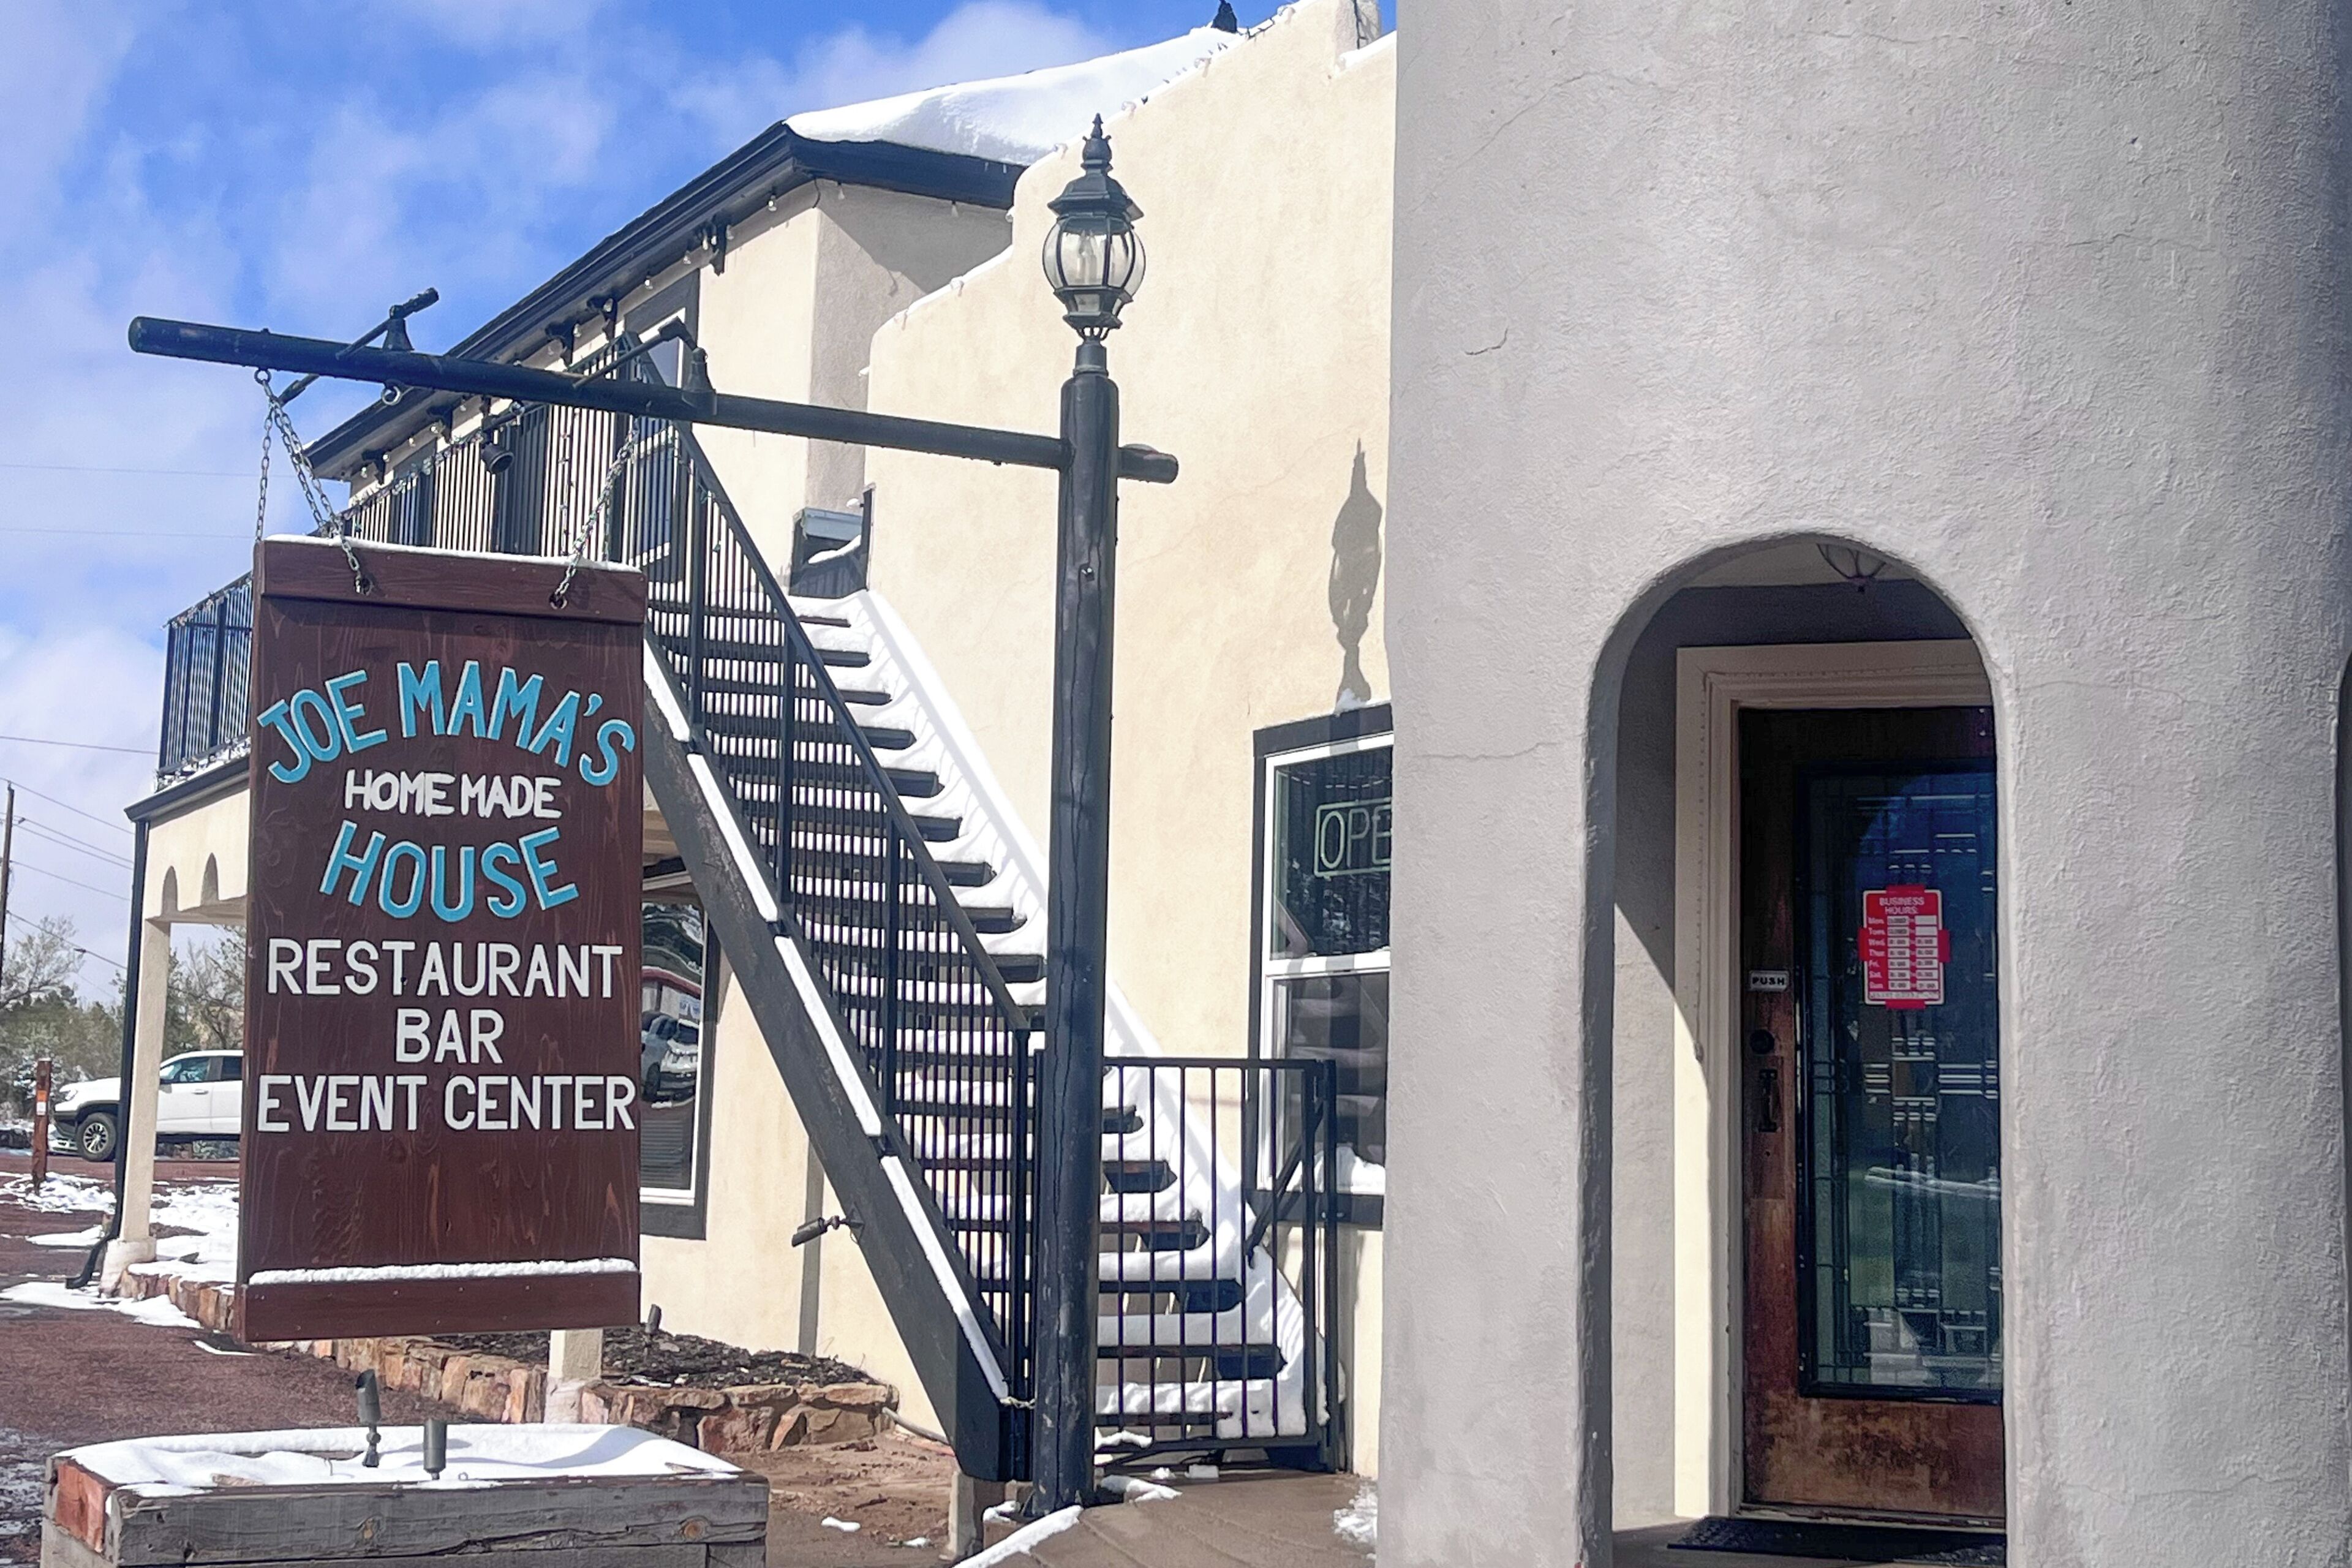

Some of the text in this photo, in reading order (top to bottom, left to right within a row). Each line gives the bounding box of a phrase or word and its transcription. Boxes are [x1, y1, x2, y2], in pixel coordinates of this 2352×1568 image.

[256, 660, 635, 785] JOE MAMA'S
[1320, 804, 1392, 869] OPE
[319, 819, 579, 922] HOUSE
[1879, 897, 1925, 906] BUSINESS
[268, 938, 624, 998] RESTAURANT
[396, 1008, 505, 1064] BAR
[257, 1075, 636, 1133] EVENT CENTER
